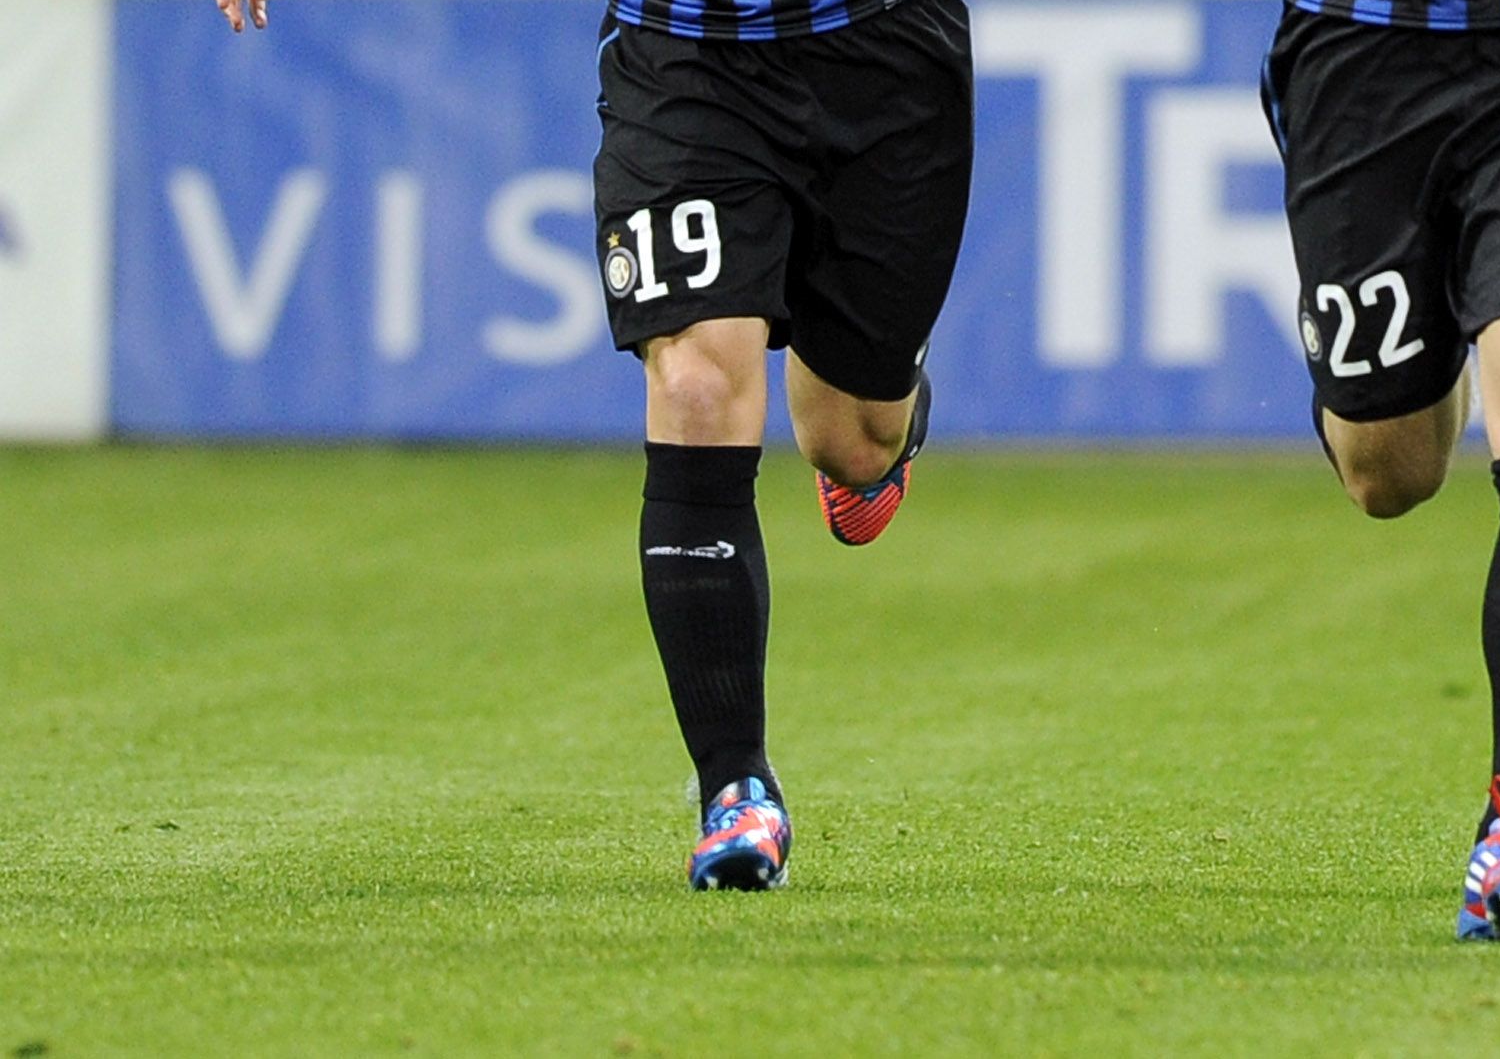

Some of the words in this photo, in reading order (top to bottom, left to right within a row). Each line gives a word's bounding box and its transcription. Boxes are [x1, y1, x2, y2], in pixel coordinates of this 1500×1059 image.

[166, 167, 605, 366] VIS
[626, 199, 722, 303] 19
[1316, 270, 1425, 377] 22
